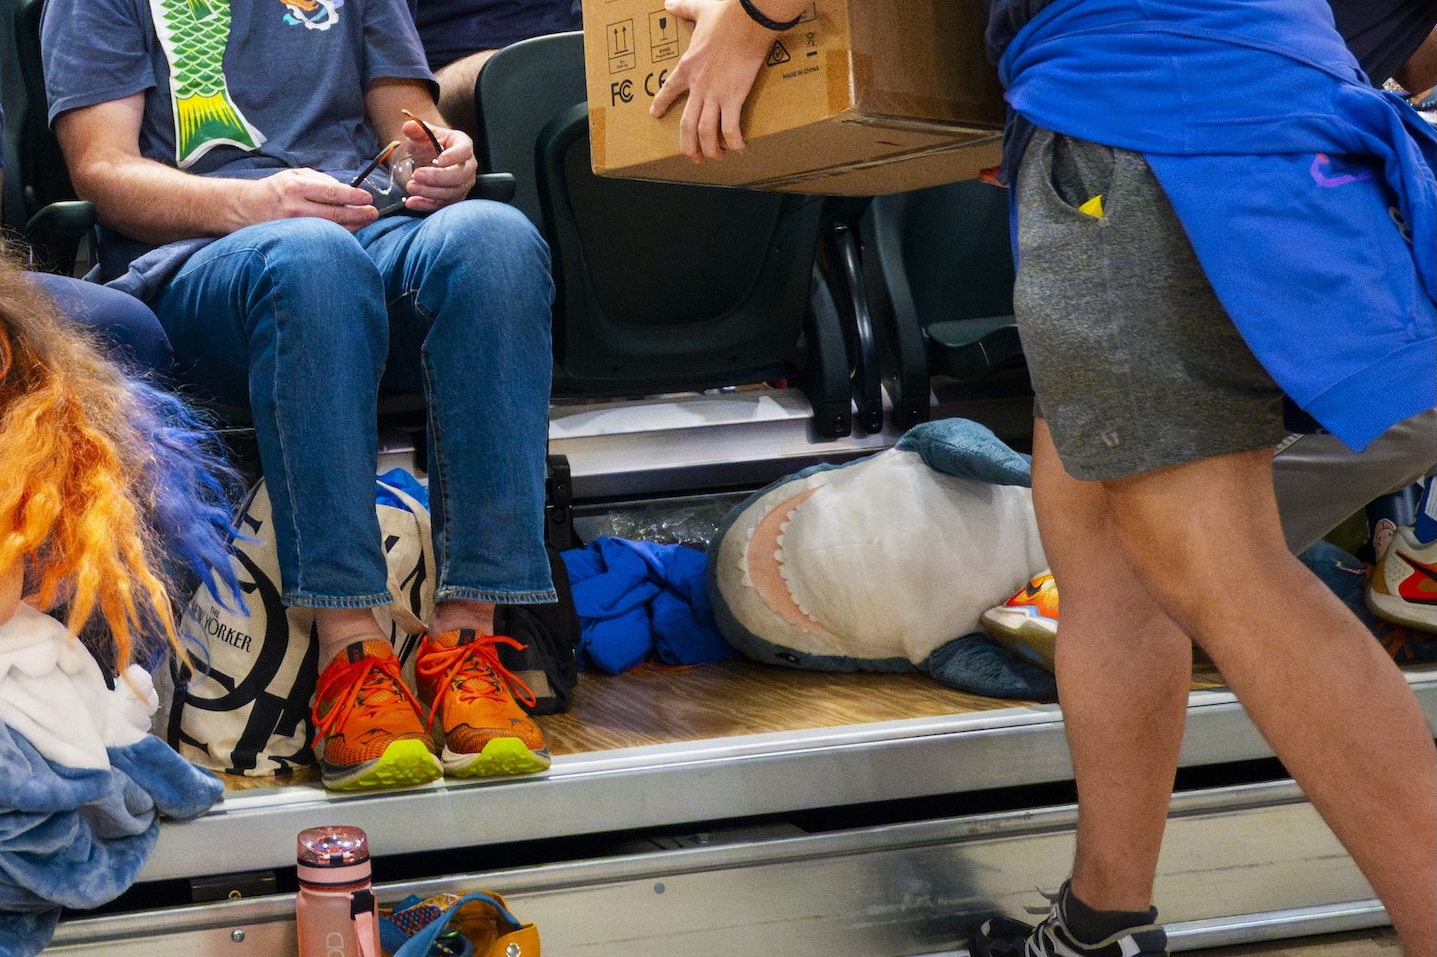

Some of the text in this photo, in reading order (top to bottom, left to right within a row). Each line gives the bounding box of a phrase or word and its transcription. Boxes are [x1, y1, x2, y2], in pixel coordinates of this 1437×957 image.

[783, 70, 797, 79] MADE
[803, 65, 820, 74] CHINA
[210, 605, 220, 618] THE
[204, 615, 252, 653] YORKER
